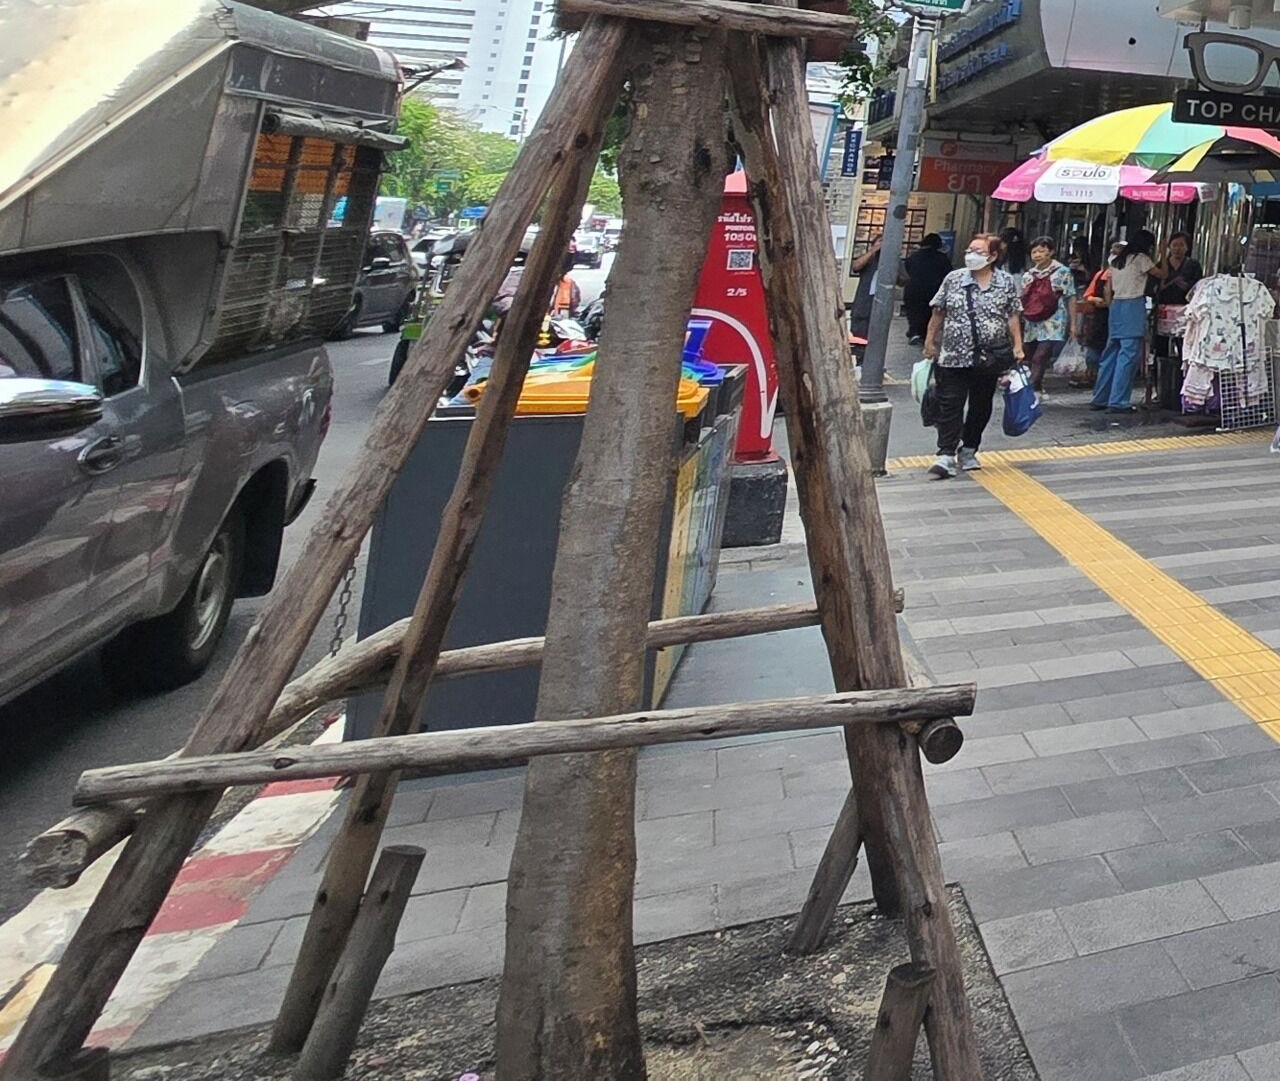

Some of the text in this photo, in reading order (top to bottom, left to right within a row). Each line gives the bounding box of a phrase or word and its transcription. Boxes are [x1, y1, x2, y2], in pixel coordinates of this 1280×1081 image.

[1186, 99, 1234, 119] TOP
[934, 159, 1000, 176] Pharmacy
[947, 173, 982, 193] ยา
[726, 287, 748, 297] 2/5
